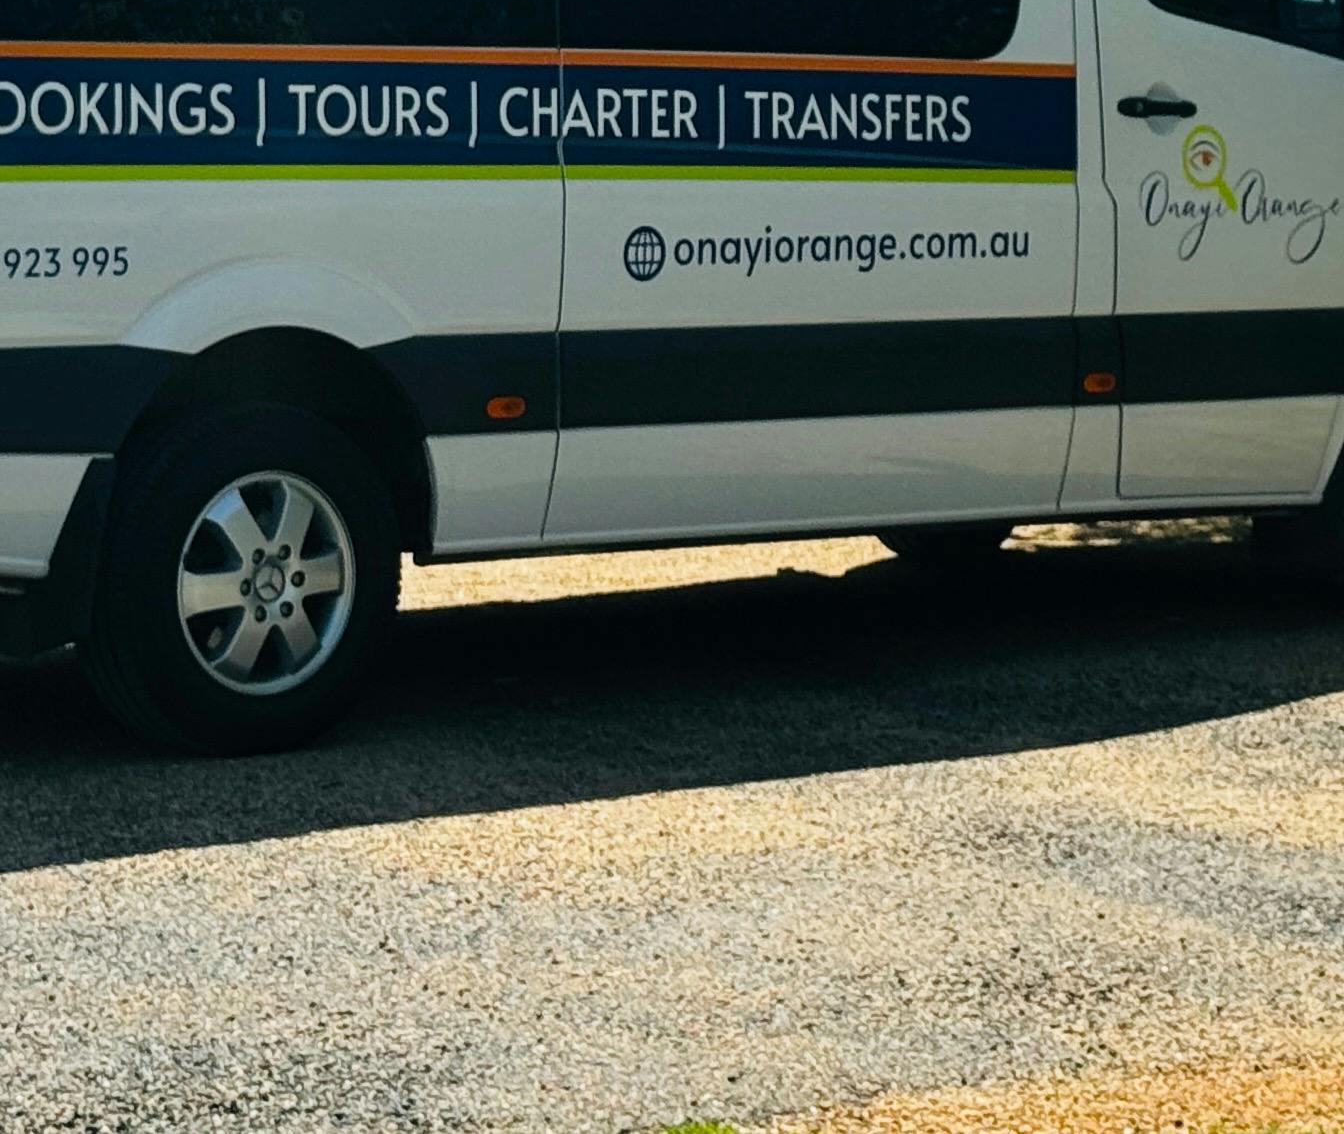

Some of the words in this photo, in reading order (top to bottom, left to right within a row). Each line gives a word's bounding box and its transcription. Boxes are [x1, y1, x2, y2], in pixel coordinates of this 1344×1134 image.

[288, 83, 451, 138] TOURS
[499, 86, 698, 139] CHARTER
[744, 90, 973, 143] TRANSFERS
[1234, 168, 1341, 265] Orange
[3, 248, 62, 279] 923
[72, 247, 130, 278] 995
[673, 225, 1030, 277] onayiorange.com.au
